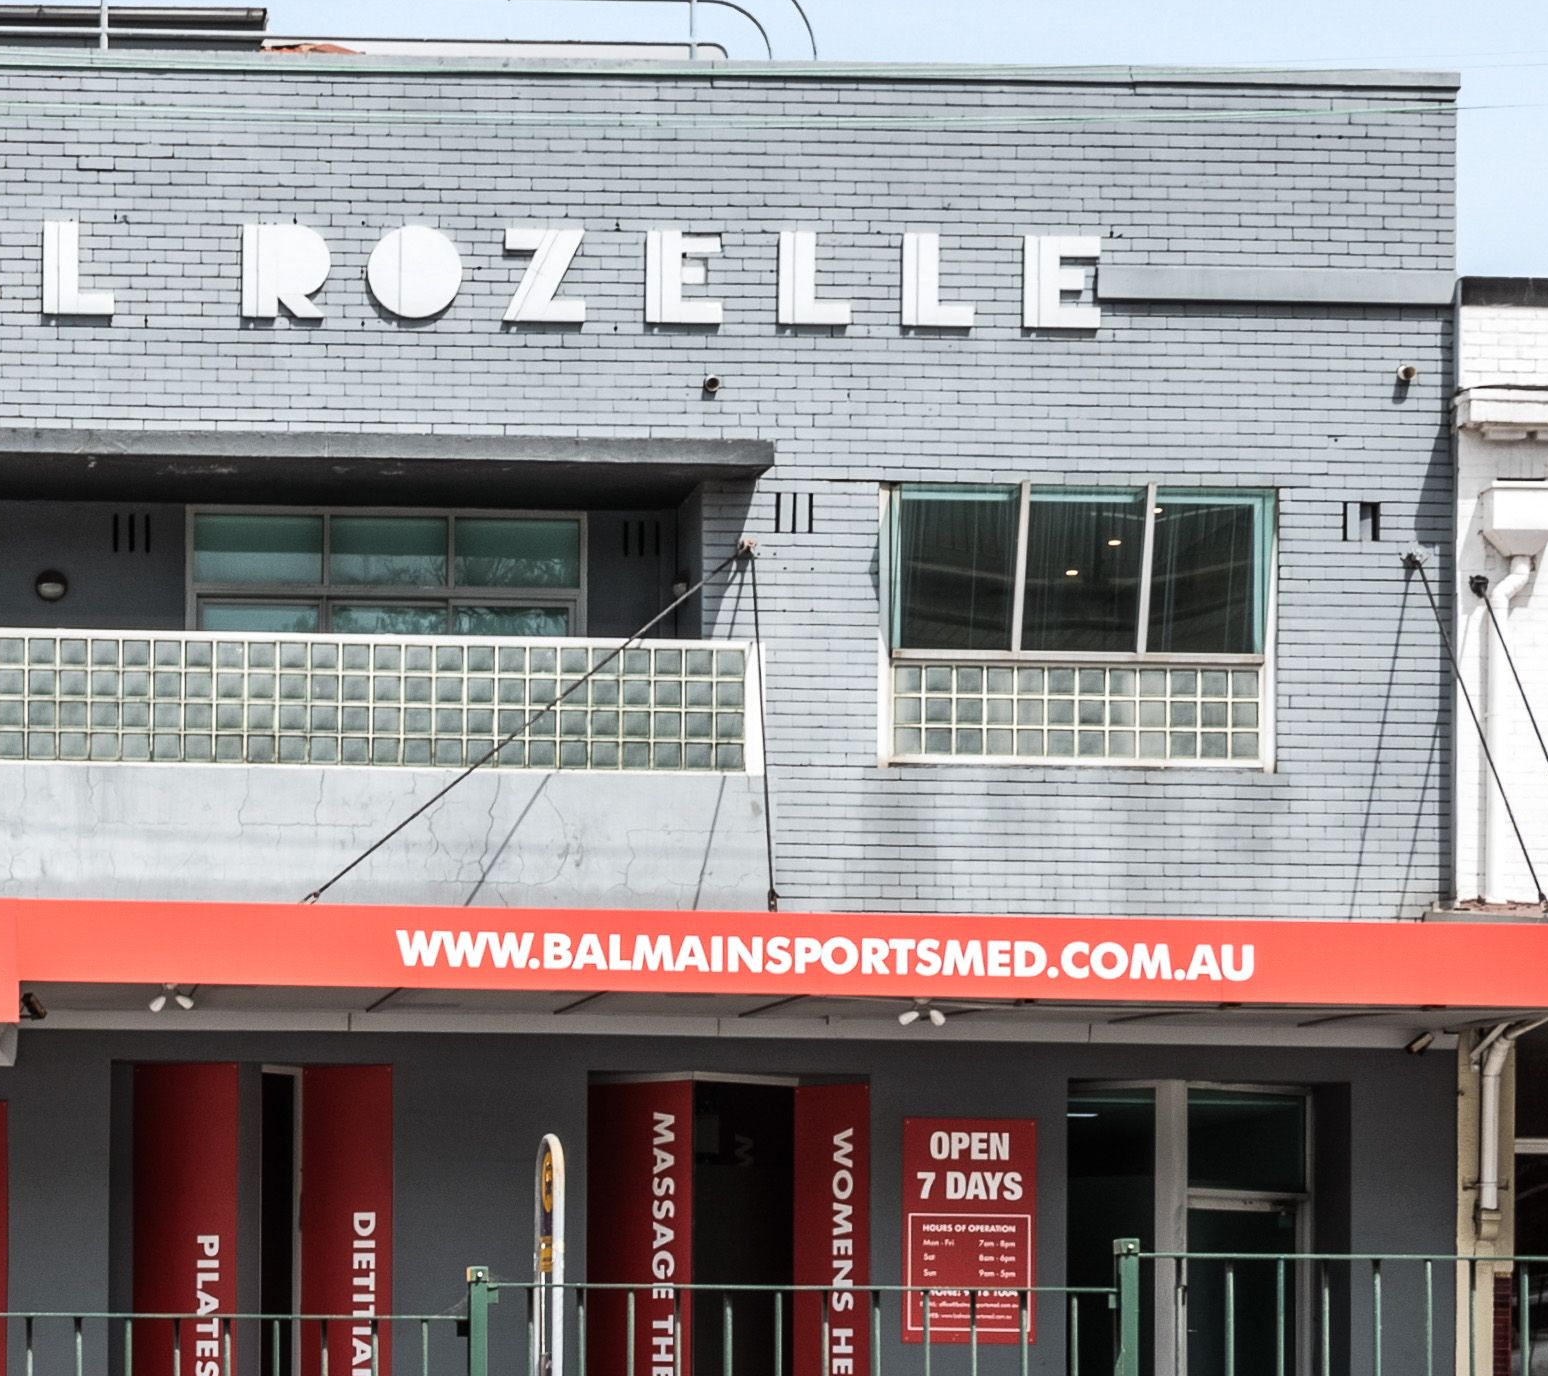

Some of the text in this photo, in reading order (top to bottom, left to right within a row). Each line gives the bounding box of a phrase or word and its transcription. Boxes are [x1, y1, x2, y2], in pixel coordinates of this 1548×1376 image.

[242, 224, 1101, 330] ROZELLE
[396, 930, 1255, 982] WWW.BALMAINSPORTSMED.COM.AU
[930, 1131, 1010, 1160] OPEN
[652, 1111, 676, 1299] MASSAGE
[917, 1171, 1023, 1201] 7 DAYS
[831, 1127, 854, 1312] WOMENS
[922, 1224, 1016, 1233] HOURS OF OPERATION
[923, 1268, 937, 1277] Sun
